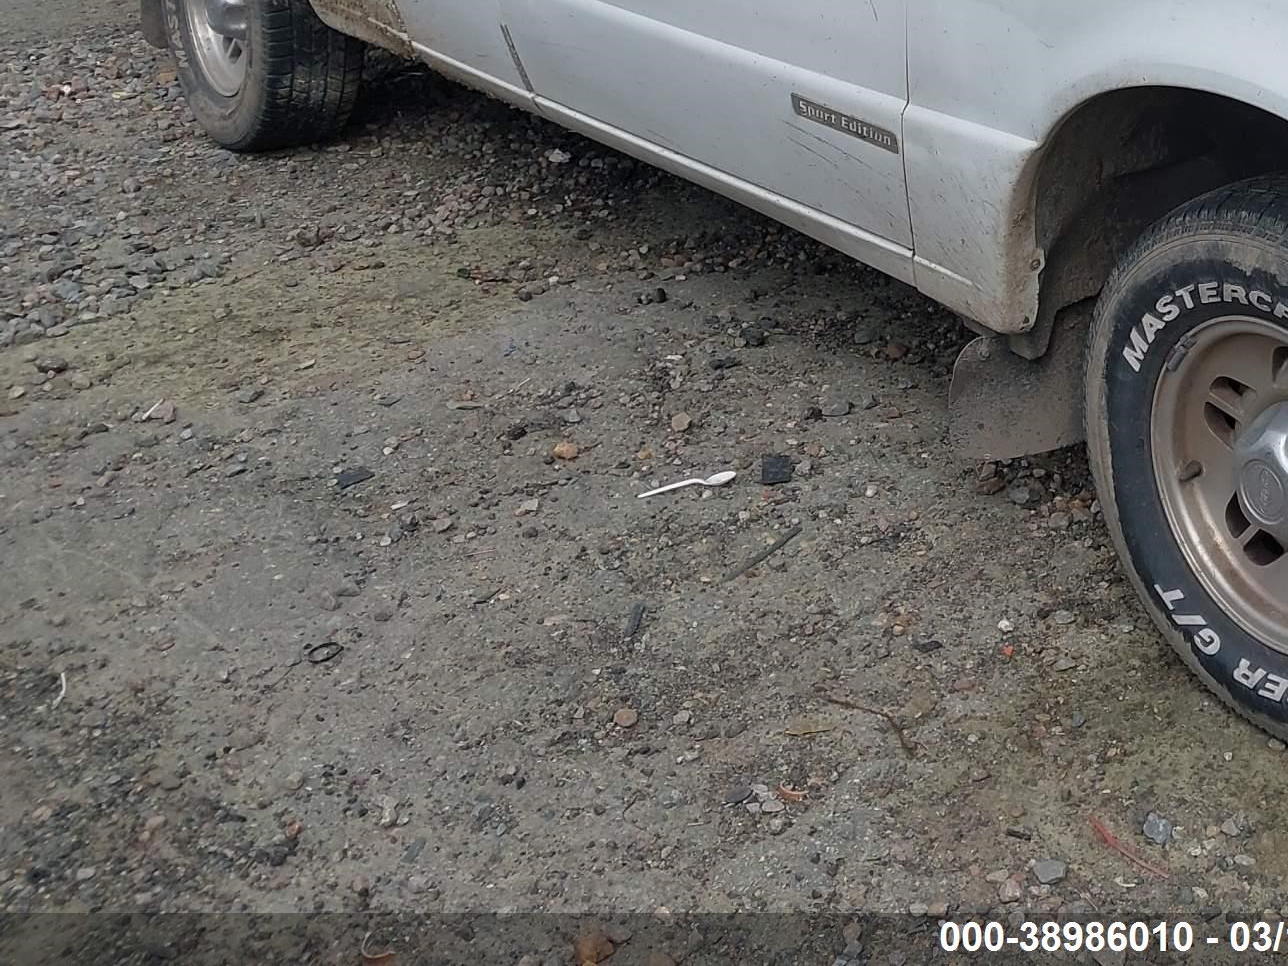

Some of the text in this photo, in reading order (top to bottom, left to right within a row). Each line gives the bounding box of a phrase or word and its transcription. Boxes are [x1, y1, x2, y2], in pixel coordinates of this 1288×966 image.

[799, 100, 892, 146] Sport Edition
[1153, 583, 1222, 656] G/T
